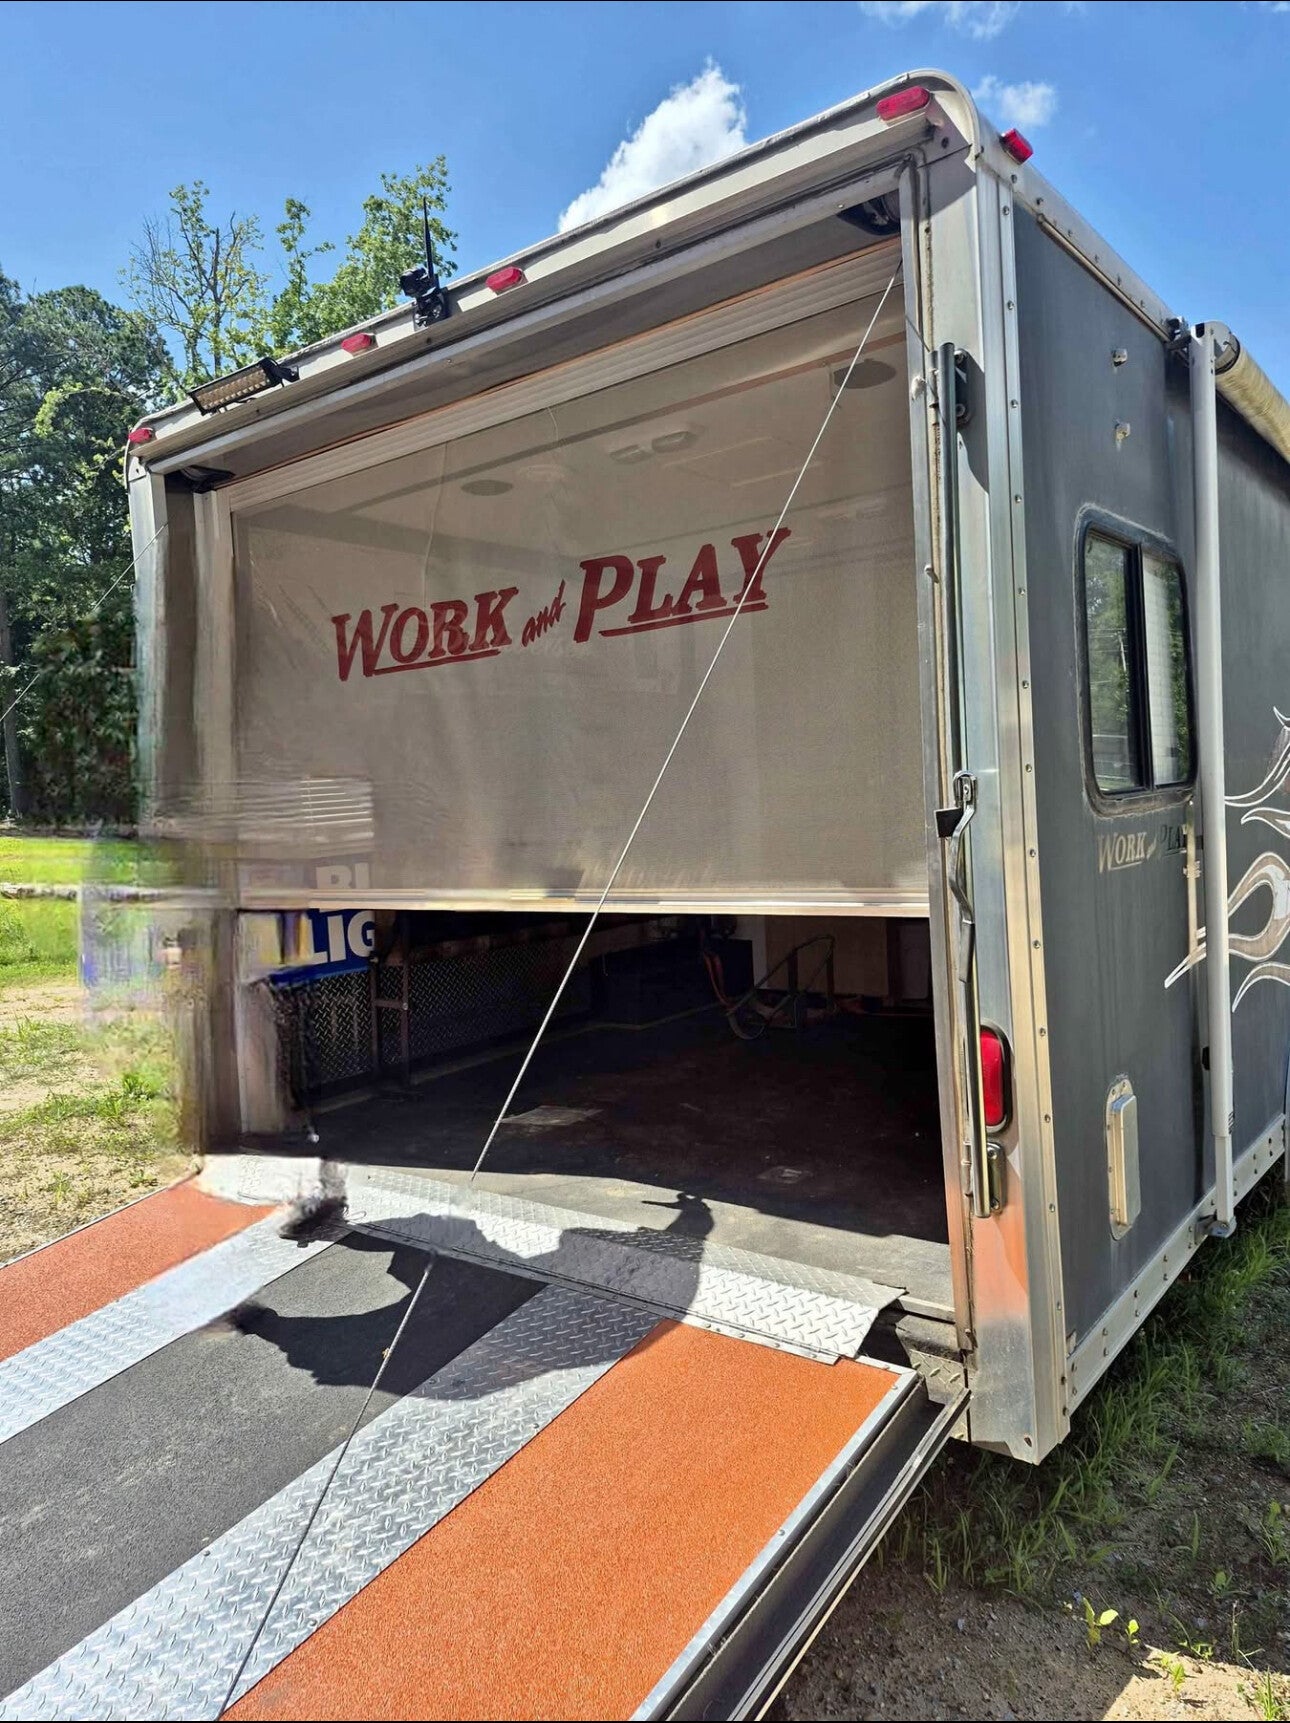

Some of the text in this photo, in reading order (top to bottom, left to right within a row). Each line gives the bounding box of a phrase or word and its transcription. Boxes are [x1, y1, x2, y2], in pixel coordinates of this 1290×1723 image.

[331, 527, 792, 682] WORK and PLAY
[1097, 831, 1147, 874] WORK
